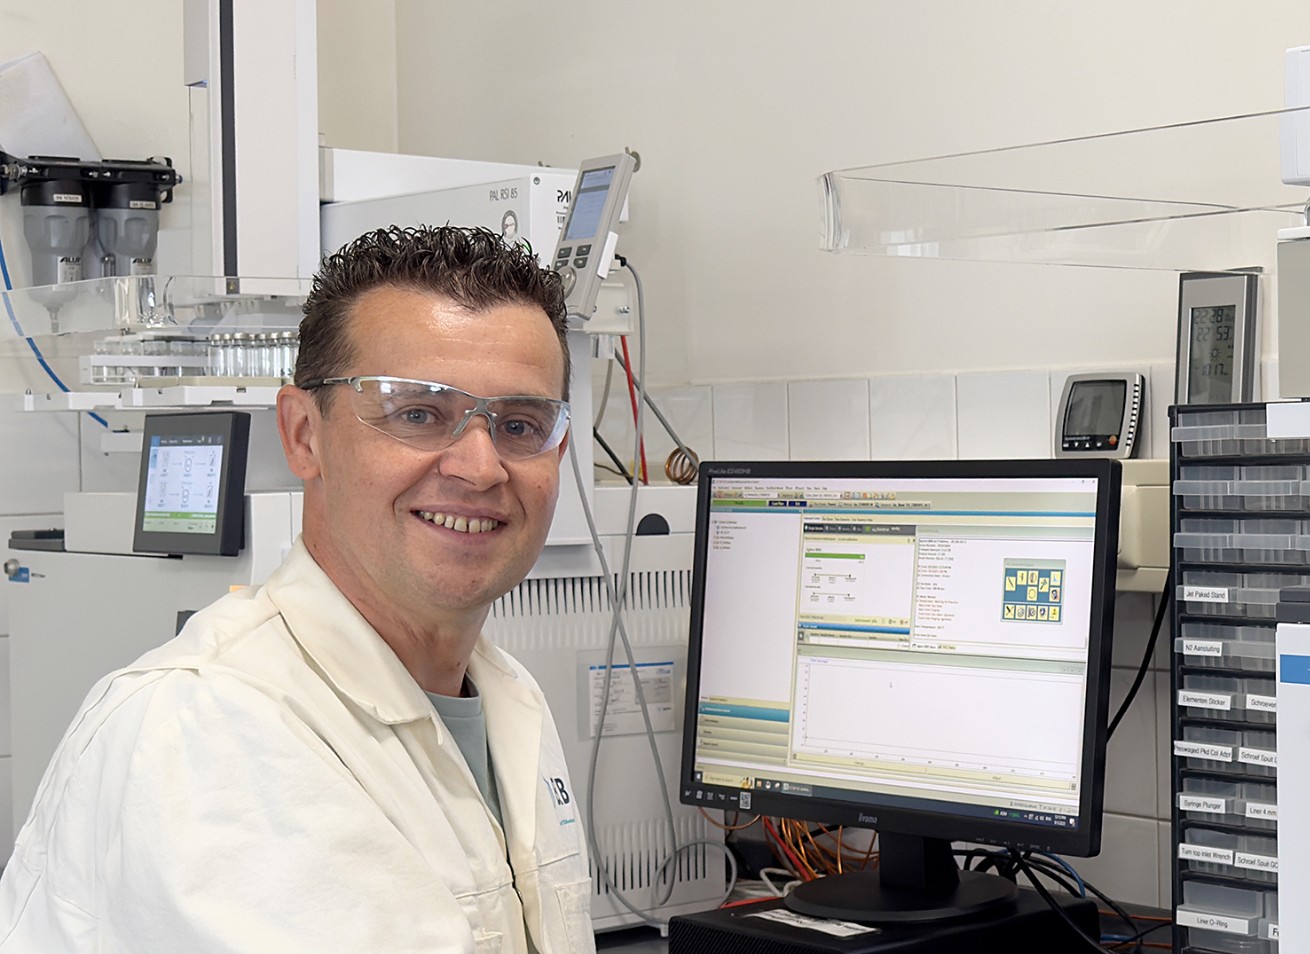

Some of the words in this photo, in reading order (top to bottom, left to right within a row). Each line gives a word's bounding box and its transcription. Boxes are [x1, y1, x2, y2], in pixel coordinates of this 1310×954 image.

[489, 190, 499, 201] PAL
[1184, 800, 1202, 808] Syringe
[1203, 801, 1221, 809] Plunger
